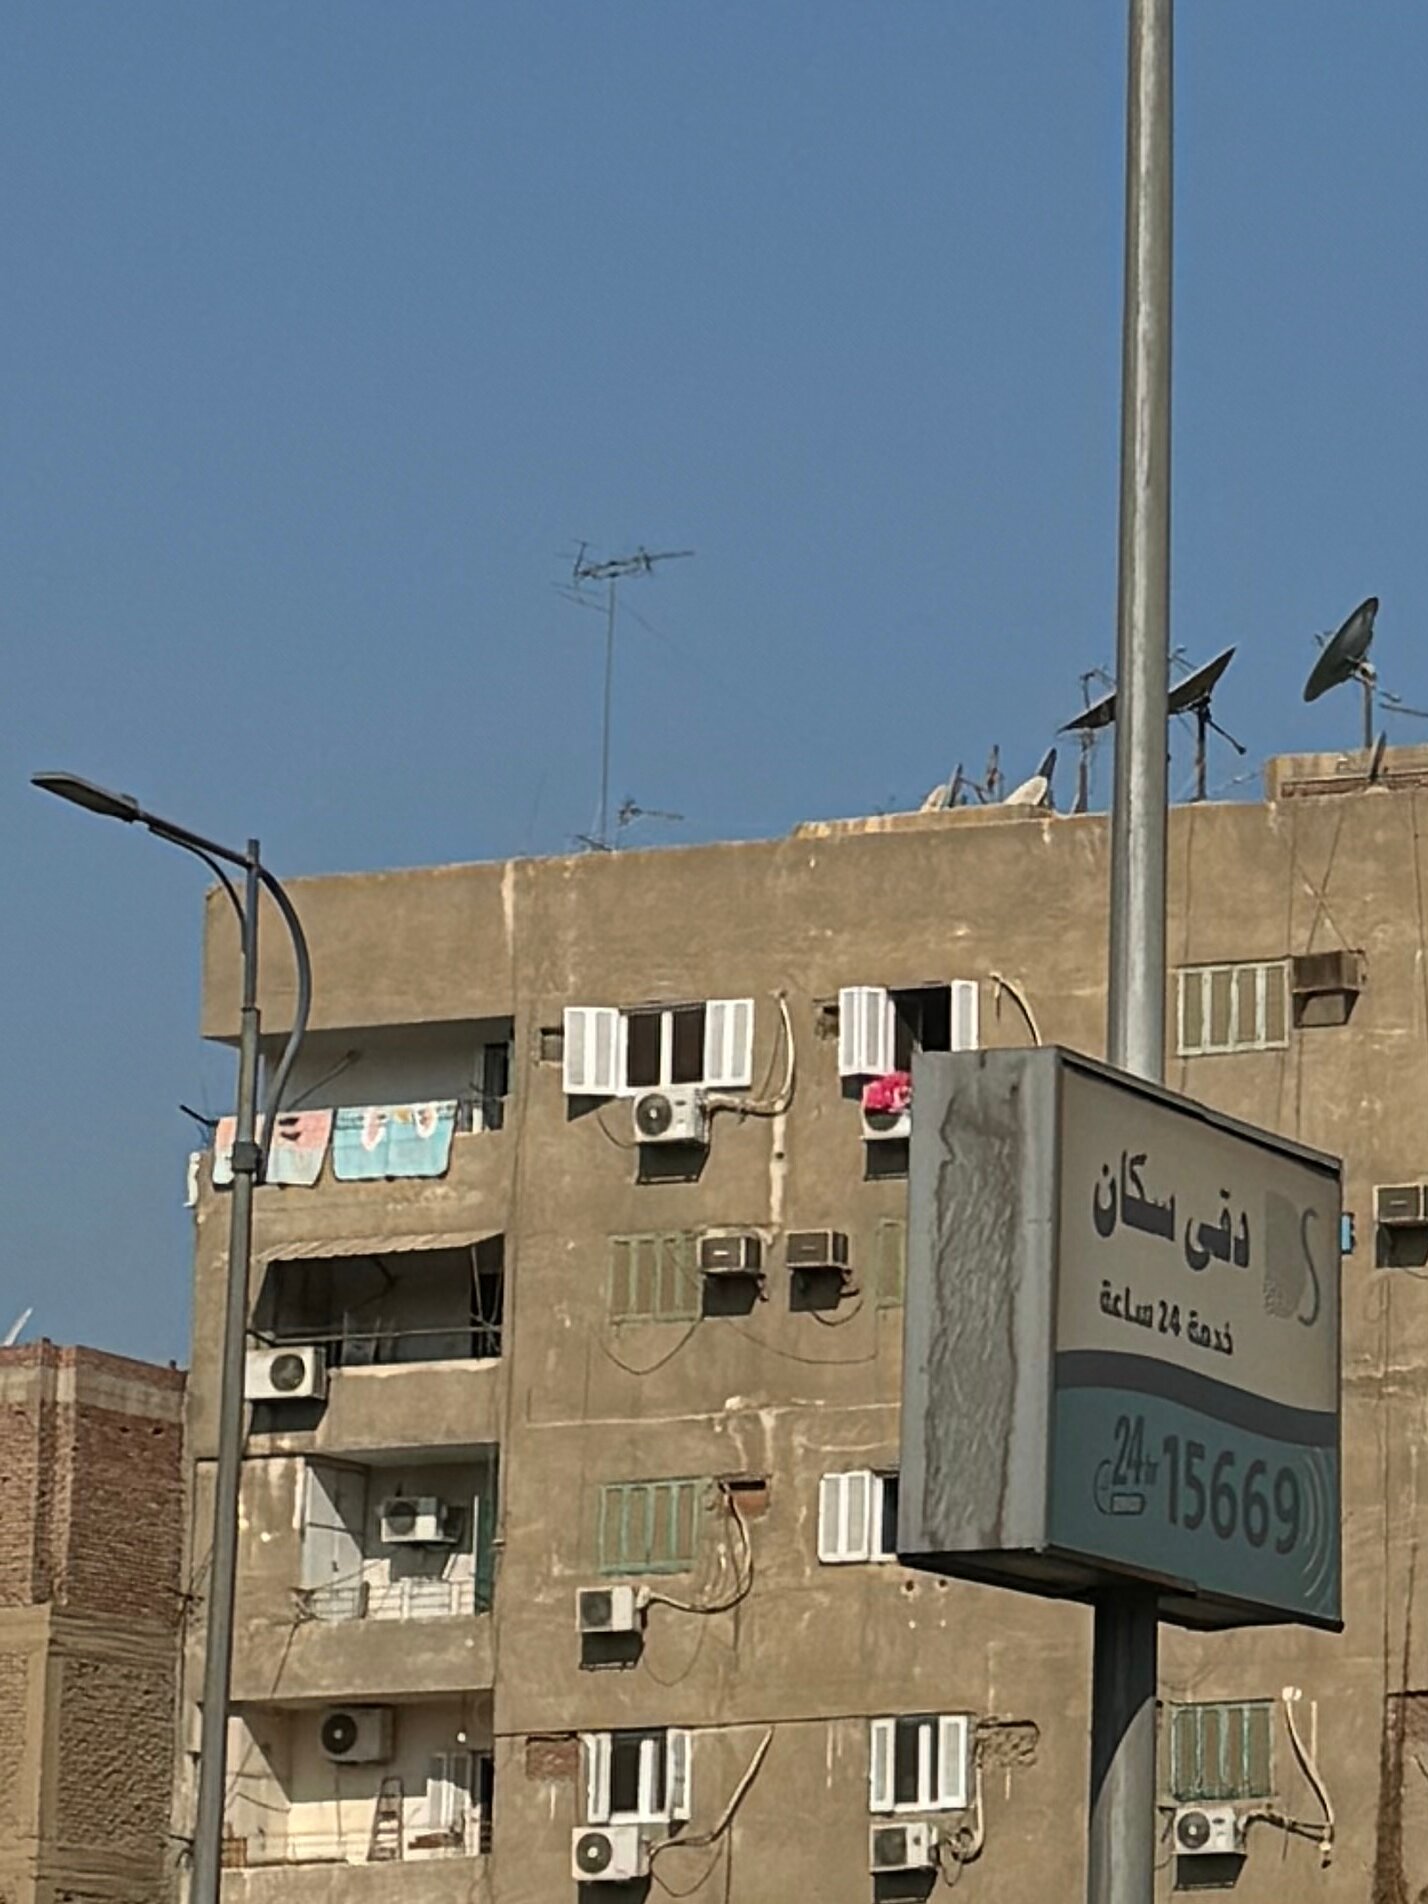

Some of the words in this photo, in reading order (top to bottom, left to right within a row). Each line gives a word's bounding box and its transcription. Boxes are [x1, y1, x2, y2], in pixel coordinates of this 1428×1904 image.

[1093, 1150, 1177, 1238] سكان
[1099, 1279, 1154, 1330] ساعة
[1158, 1299, 1182, 1338] 24
[1187, 1309, 1234, 1356] خدمة
[1163, 1434, 1302, 1556] 15669
